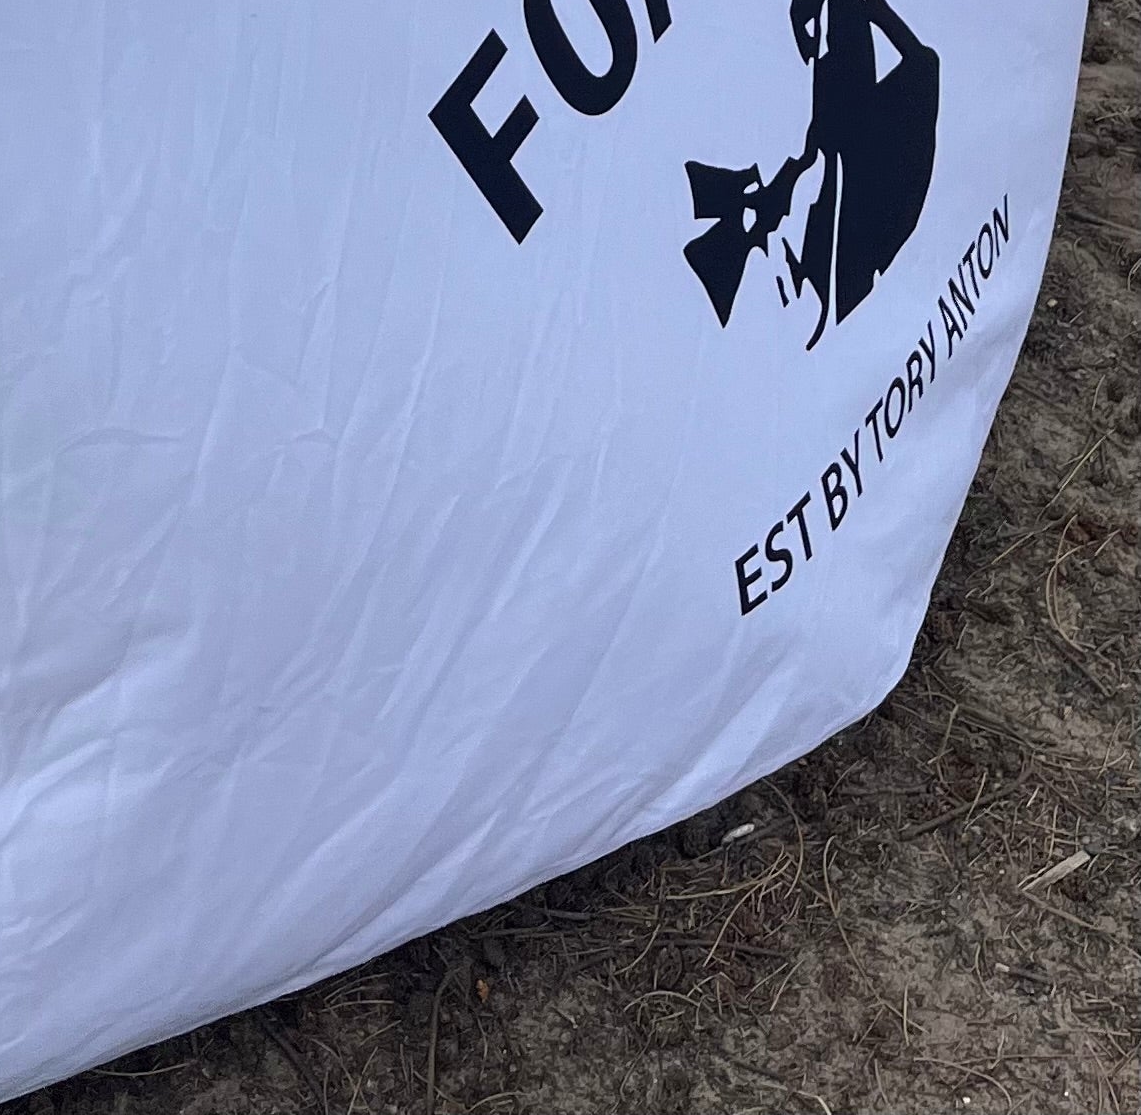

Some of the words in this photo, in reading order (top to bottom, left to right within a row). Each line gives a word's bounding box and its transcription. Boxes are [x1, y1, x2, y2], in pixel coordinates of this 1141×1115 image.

[734, 490, 812, 616] EST
[820, 427, 864, 531] BY
[865, 320, 936, 463] TORY
[937, 193, 1011, 359] ANTON
